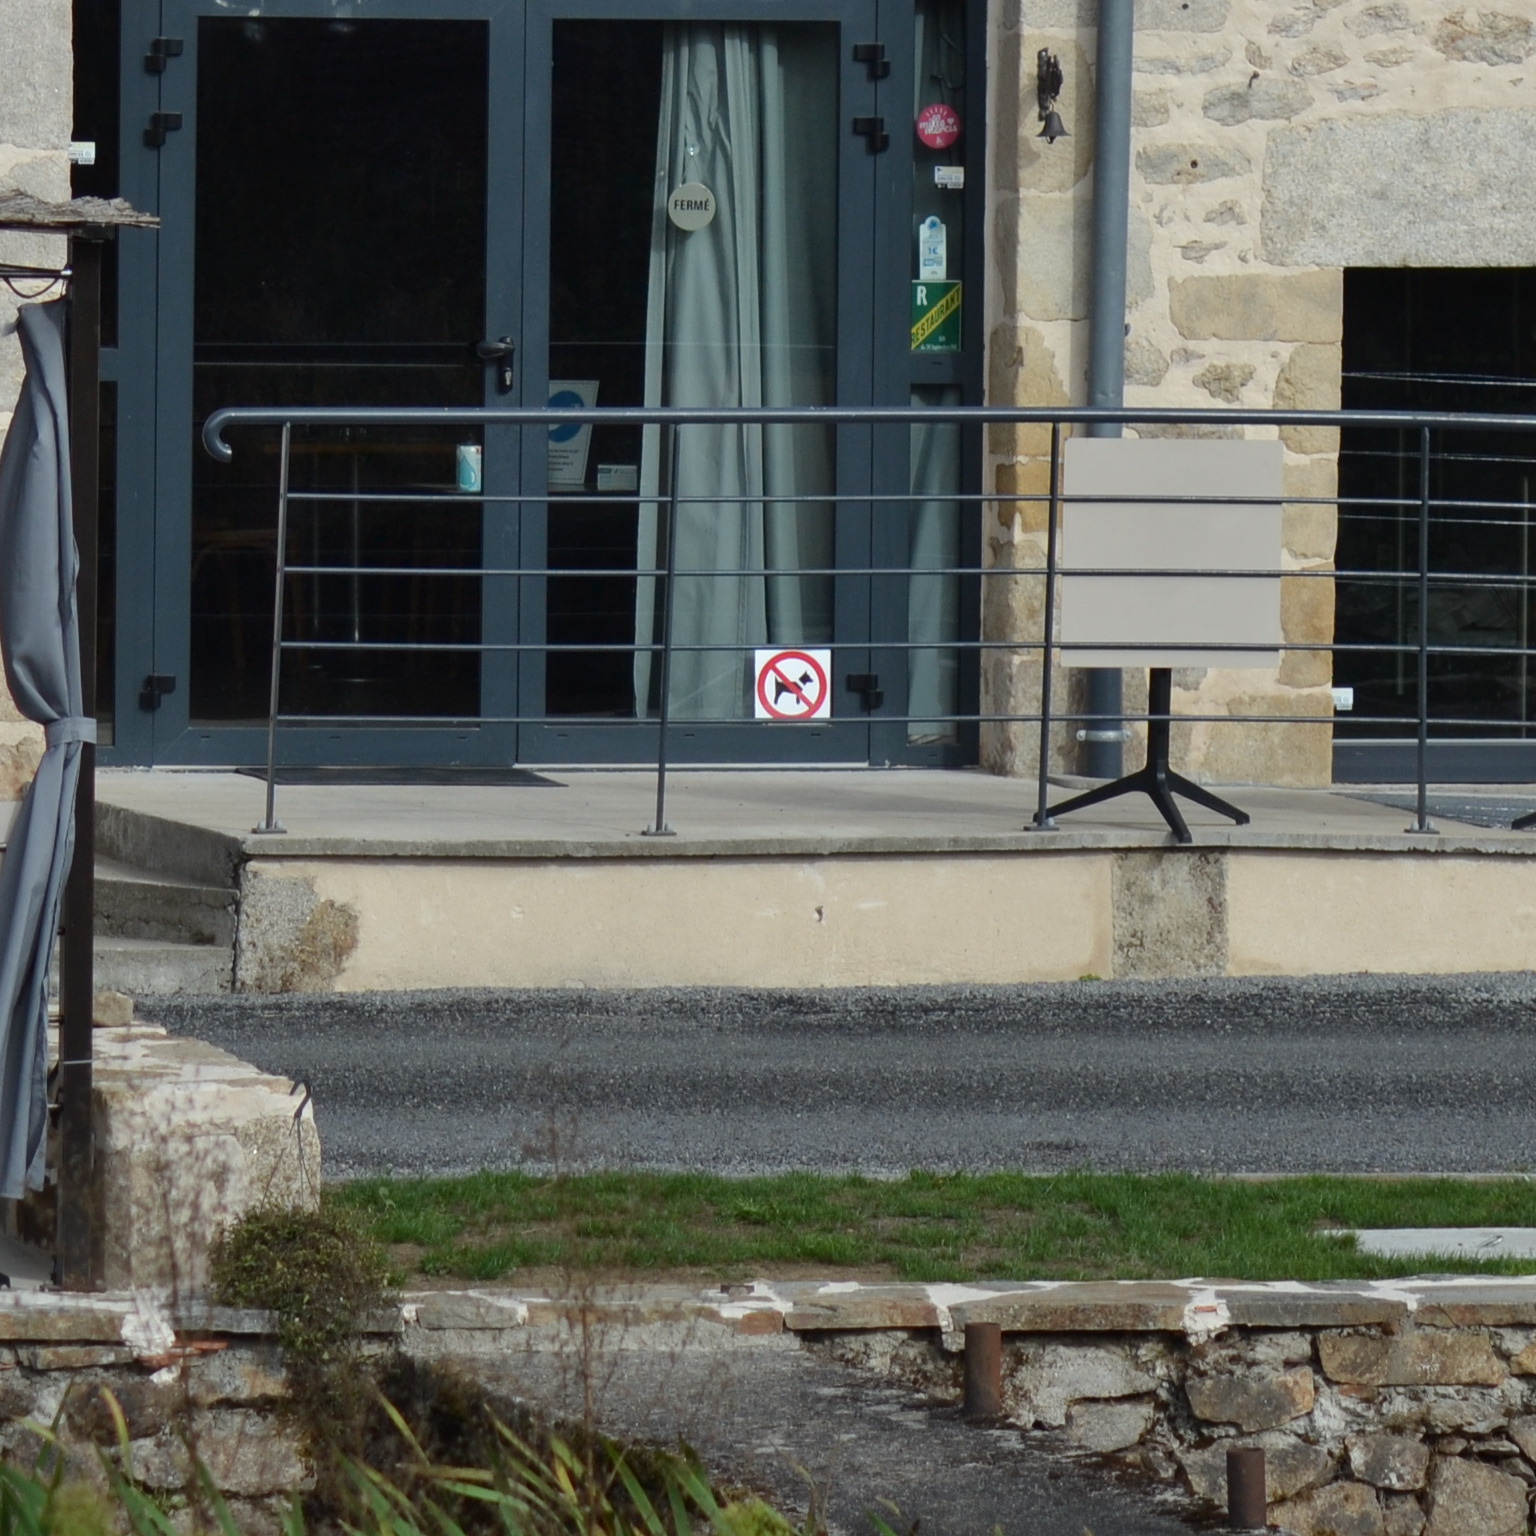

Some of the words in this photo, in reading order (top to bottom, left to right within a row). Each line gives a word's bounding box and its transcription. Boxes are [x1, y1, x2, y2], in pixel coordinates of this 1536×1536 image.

[673, 197, 711, 211] FERMÉ
[916, 285, 928, 306] R
[911, 288, 960, 343] RESTAURANT
